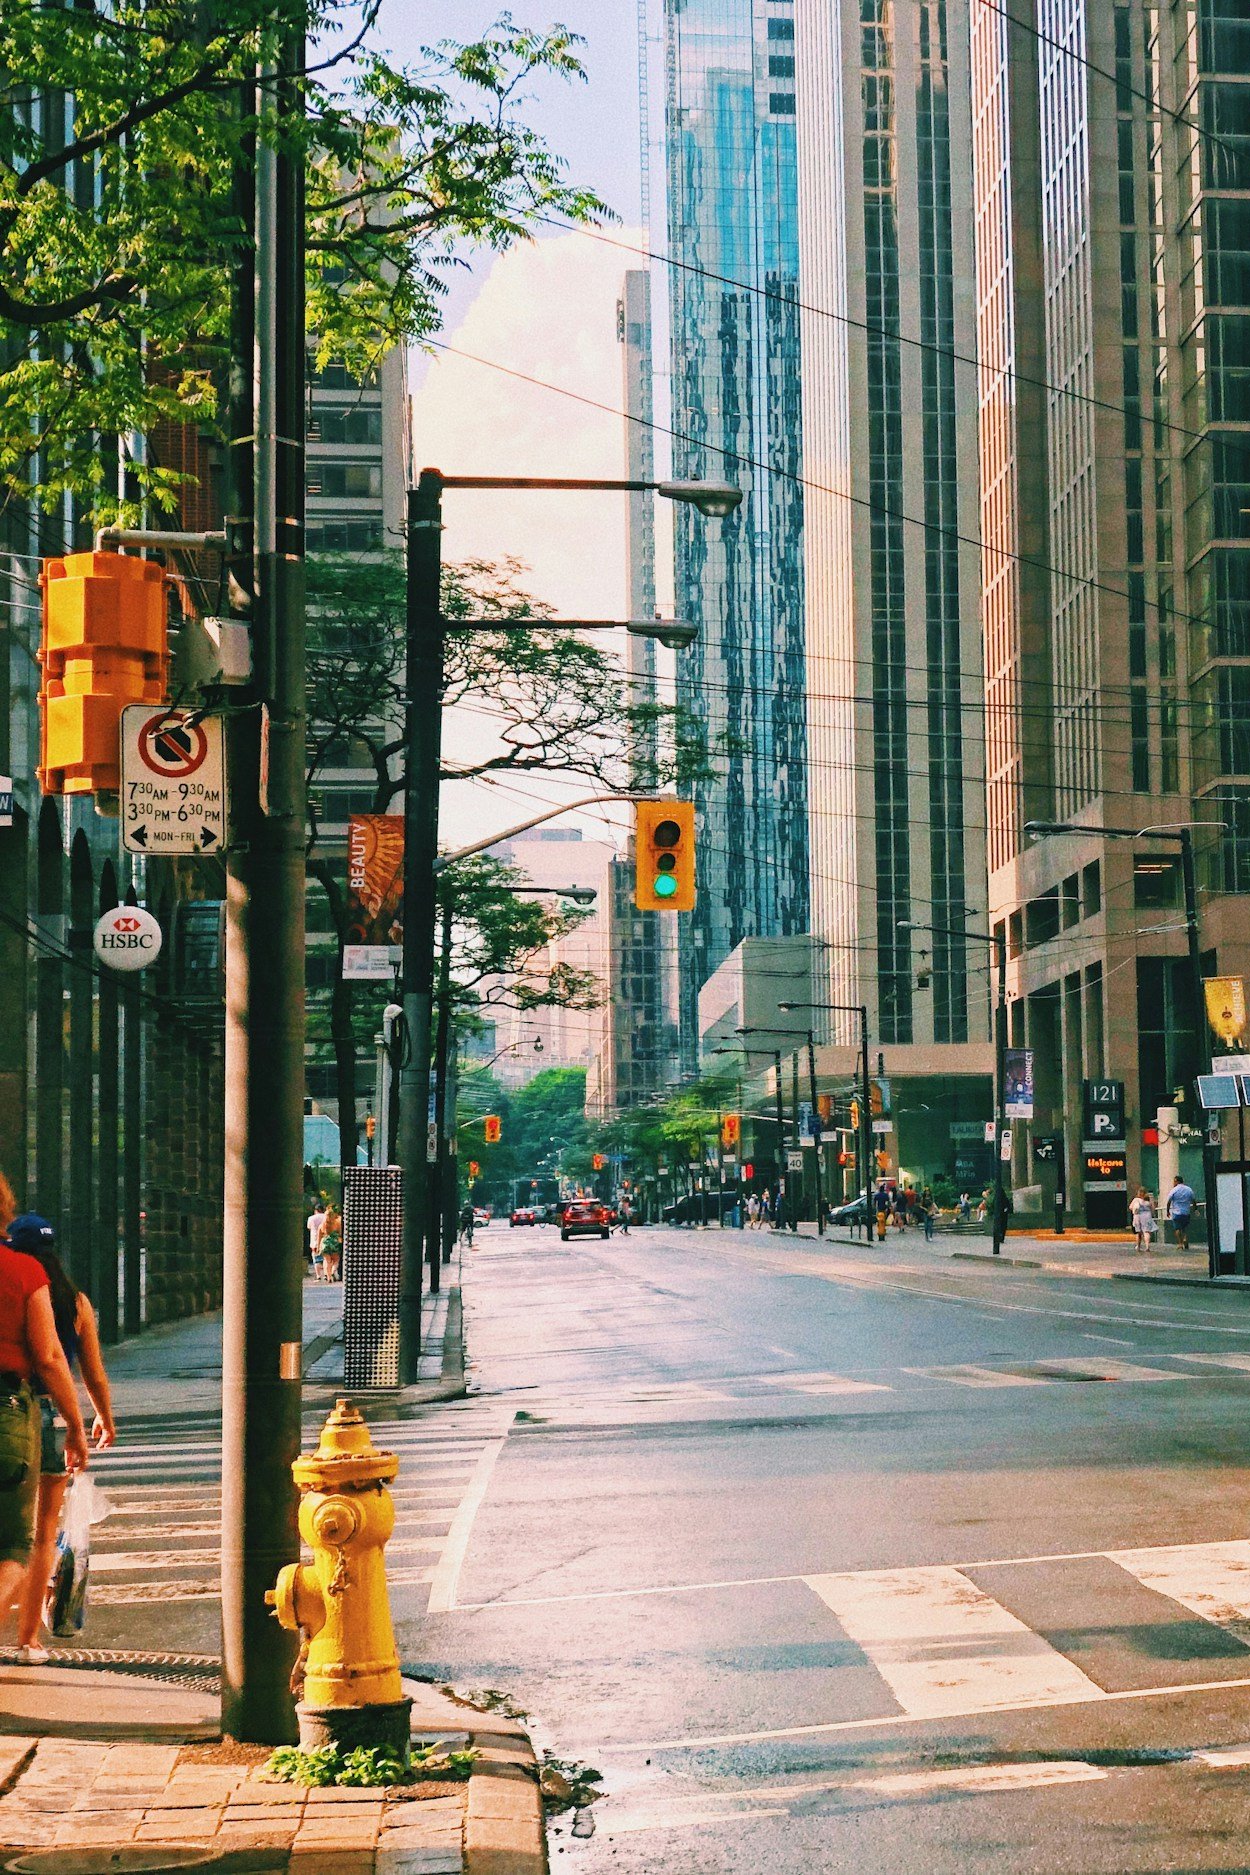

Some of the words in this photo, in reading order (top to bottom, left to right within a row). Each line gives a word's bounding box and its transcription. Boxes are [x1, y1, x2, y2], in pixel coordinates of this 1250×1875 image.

[153, 832, 195, 841] MON-FRI
[349, 823, 367, 888] BEAUTY
[101, 933, 153, 949] HSBC
[1025, 1051, 1034, 1086] CONNECT
[1093, 1085, 1117, 1101] 121
[1093, 1114, 1110, 1133] P
[789, 1159, 802, 1168] 40
[1087, 1158, 1124, 1168] Welcome
[1100, 1166, 1111, 1175] to
